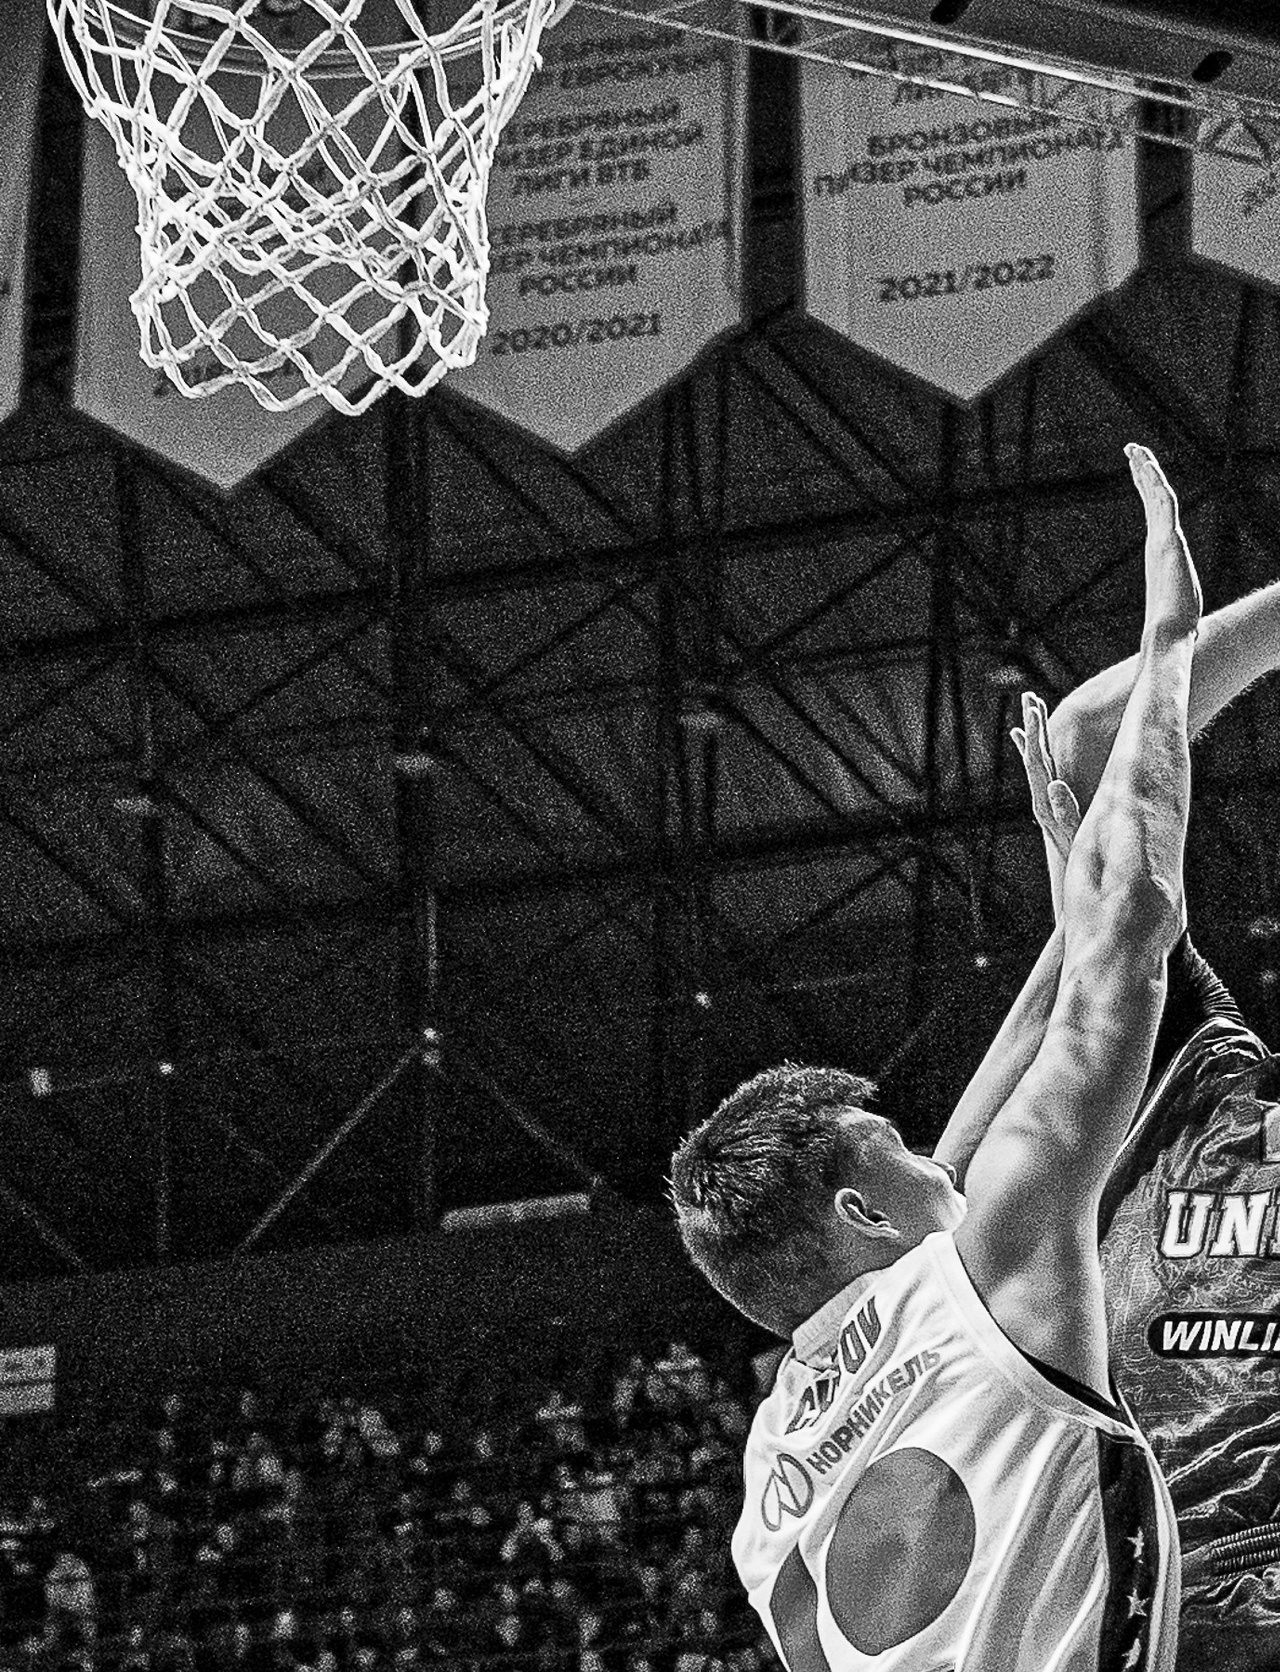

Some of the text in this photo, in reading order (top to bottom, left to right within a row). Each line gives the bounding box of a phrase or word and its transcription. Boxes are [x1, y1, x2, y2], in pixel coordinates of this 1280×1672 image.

[502, 98, 681, 145] ЕРЕБРЯНЫЙ
[580, 121, 704, 163] ЕДИНОЙ
[511, 160, 651, 198] ЛИГИ ВТБ
[903, 170, 1027, 208] РОССИИ
[518, 265, 639, 298] РОССИИ
[877, 254, 1057, 303] 2021/2022
[491, 313, 664, 356] 2020/2021
[806, 1349, 941, 1475] НОРНИКЕЛЬ
